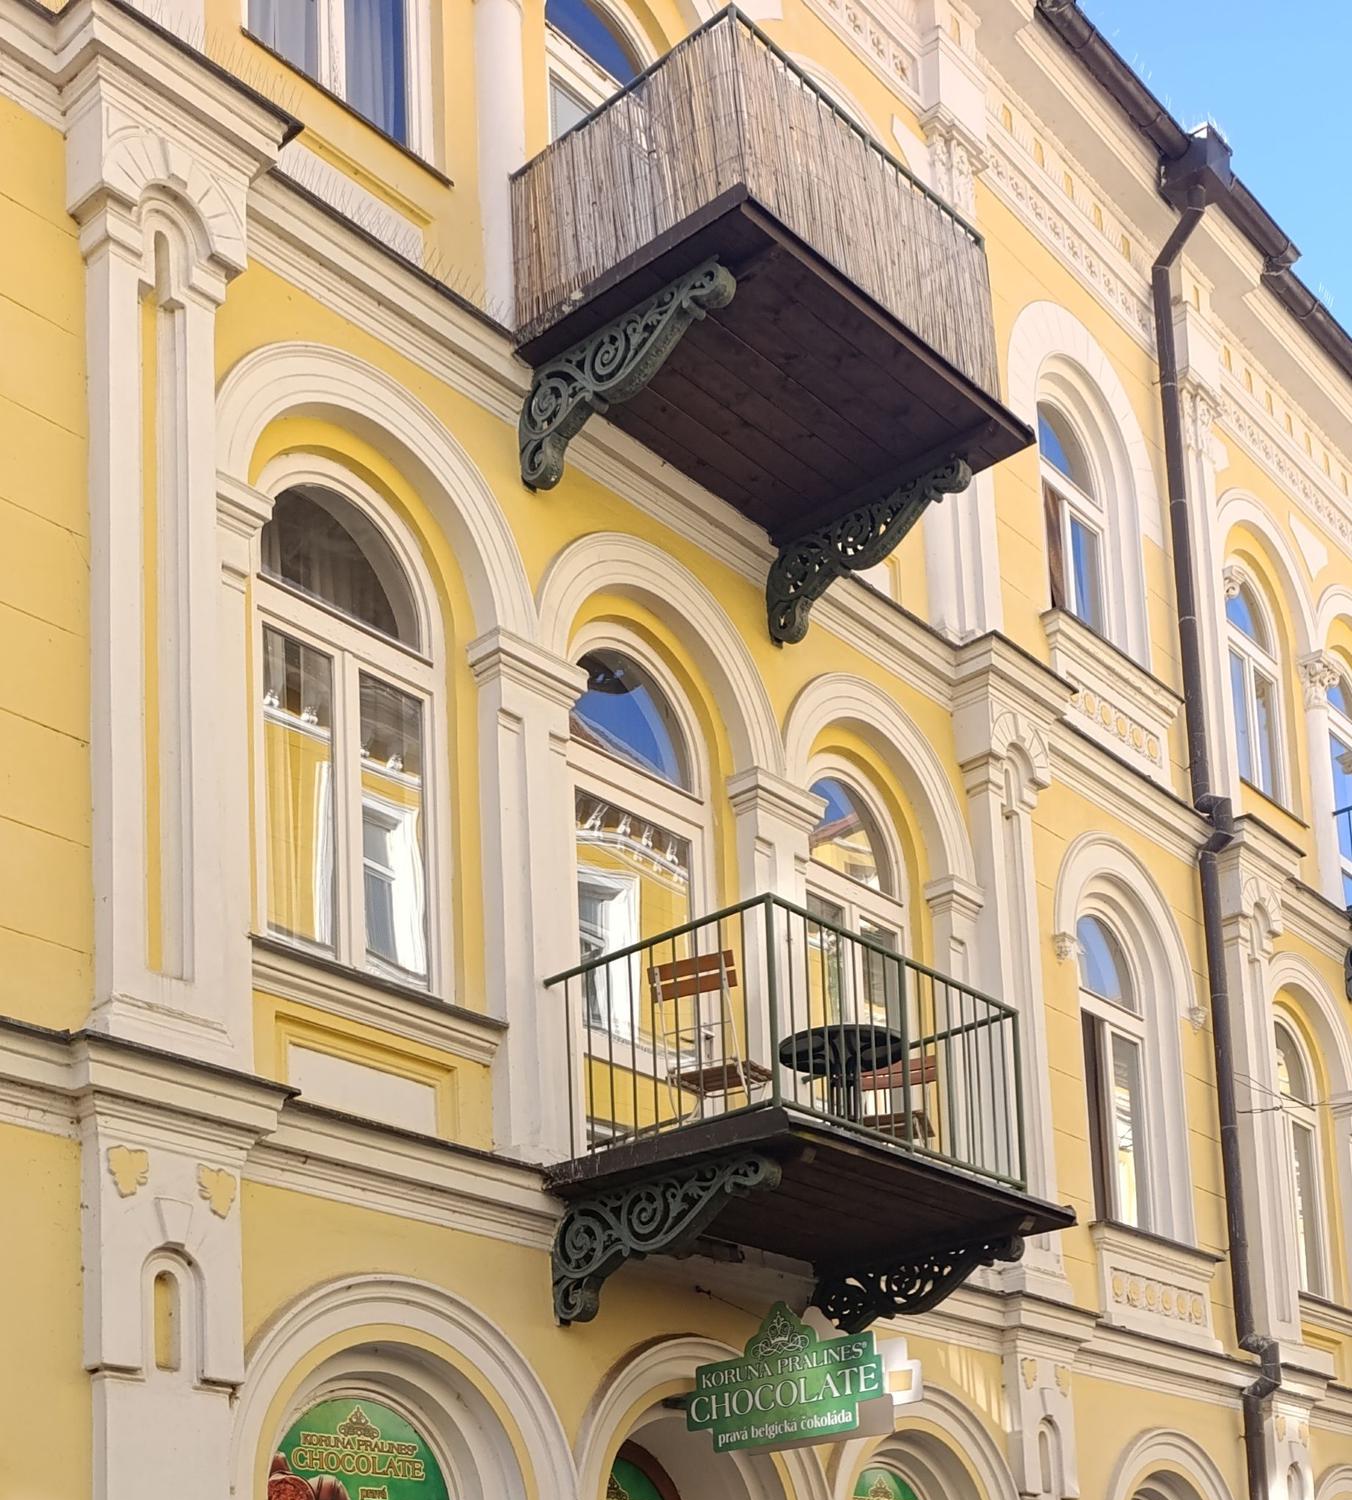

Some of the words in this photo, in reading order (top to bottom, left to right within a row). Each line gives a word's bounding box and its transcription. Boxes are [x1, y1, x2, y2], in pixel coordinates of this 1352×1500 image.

[702, 1363, 772, 1389] KORUNA
[690, 1362, 880, 1424] CHOCOLATE
[301, 1432, 355, 1450] KORUNA
[717, 1425, 749, 1447] pravá
[751, 1419, 799, 1440] belgická
[800, 1408, 852, 1431] čokoláda
[292, 1449, 425, 1480] CHOCOLATE
